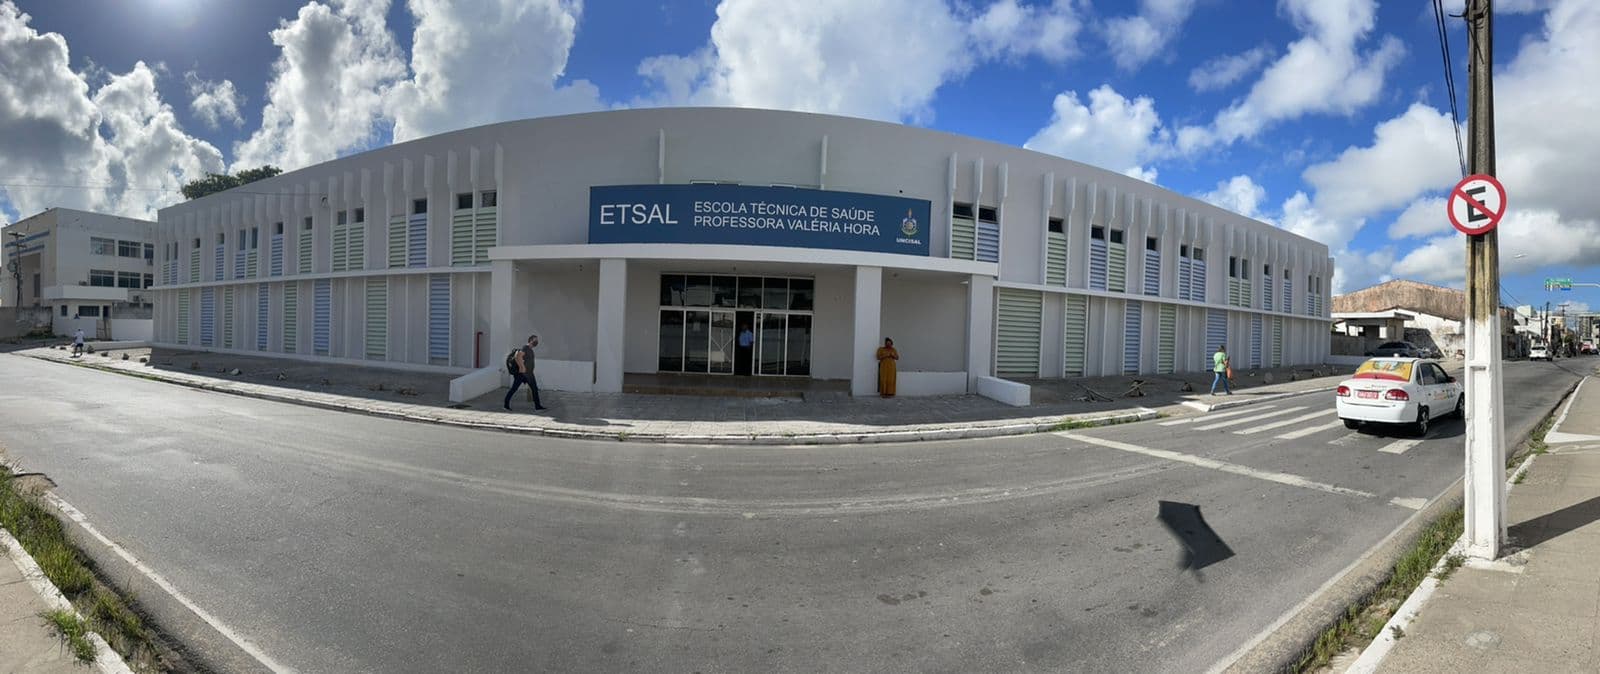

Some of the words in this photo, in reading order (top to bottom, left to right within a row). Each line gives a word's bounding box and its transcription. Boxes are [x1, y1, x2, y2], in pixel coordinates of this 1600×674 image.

[600, 203, 678, 225] ETSAL
[694, 201, 748, 214] ESCOLA
[750, 201, 807, 216] TÉCNICA
[810, 206, 828, 218] DE
[831, 207, 875, 222] SAÚDE
[694, 215, 785, 230] PROFESSORA
[787, 218, 841, 233] VALÉRIA
[843, 223, 880, 236] HORA
